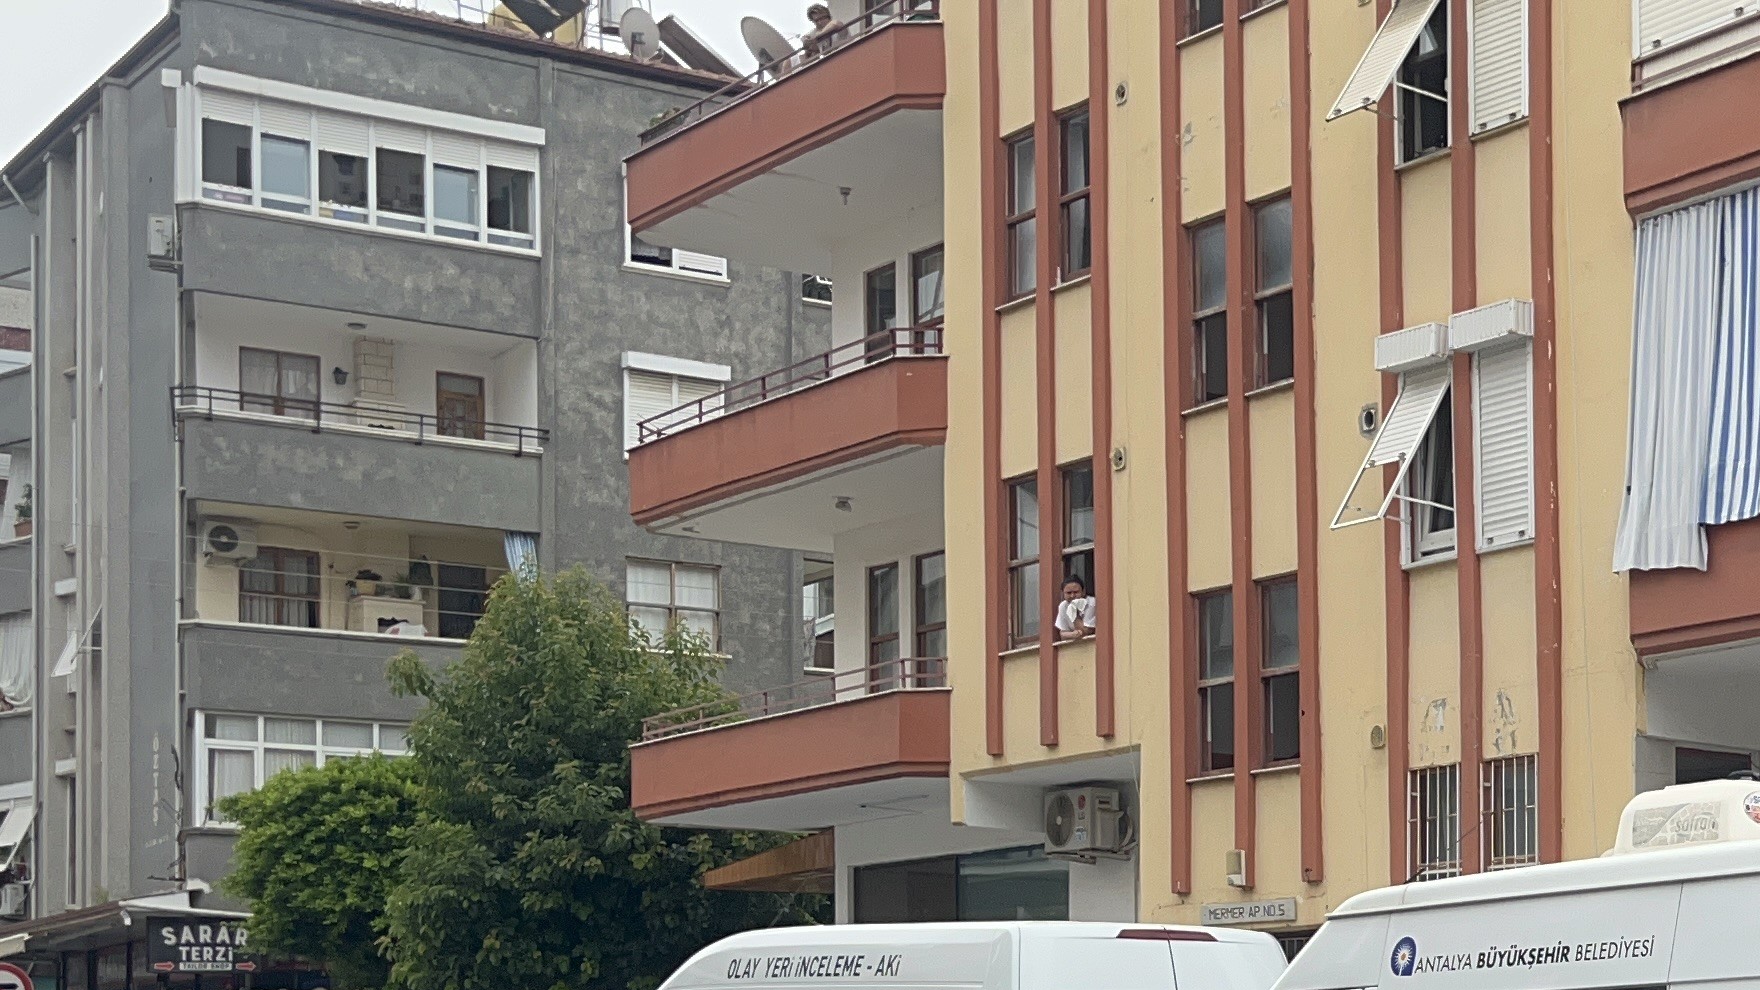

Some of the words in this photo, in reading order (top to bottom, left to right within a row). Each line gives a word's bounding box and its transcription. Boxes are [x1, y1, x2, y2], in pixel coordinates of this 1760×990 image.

[1208, 907, 1245, 920] MERMER
[1415, 953, 1472, 974] ANTALYA
[1476, 941, 1571, 969] BÜYÜKŞEHİR
[1575, 935, 1655, 961] BELEDİYESİ
[727, 957, 761, 979] OLAY
